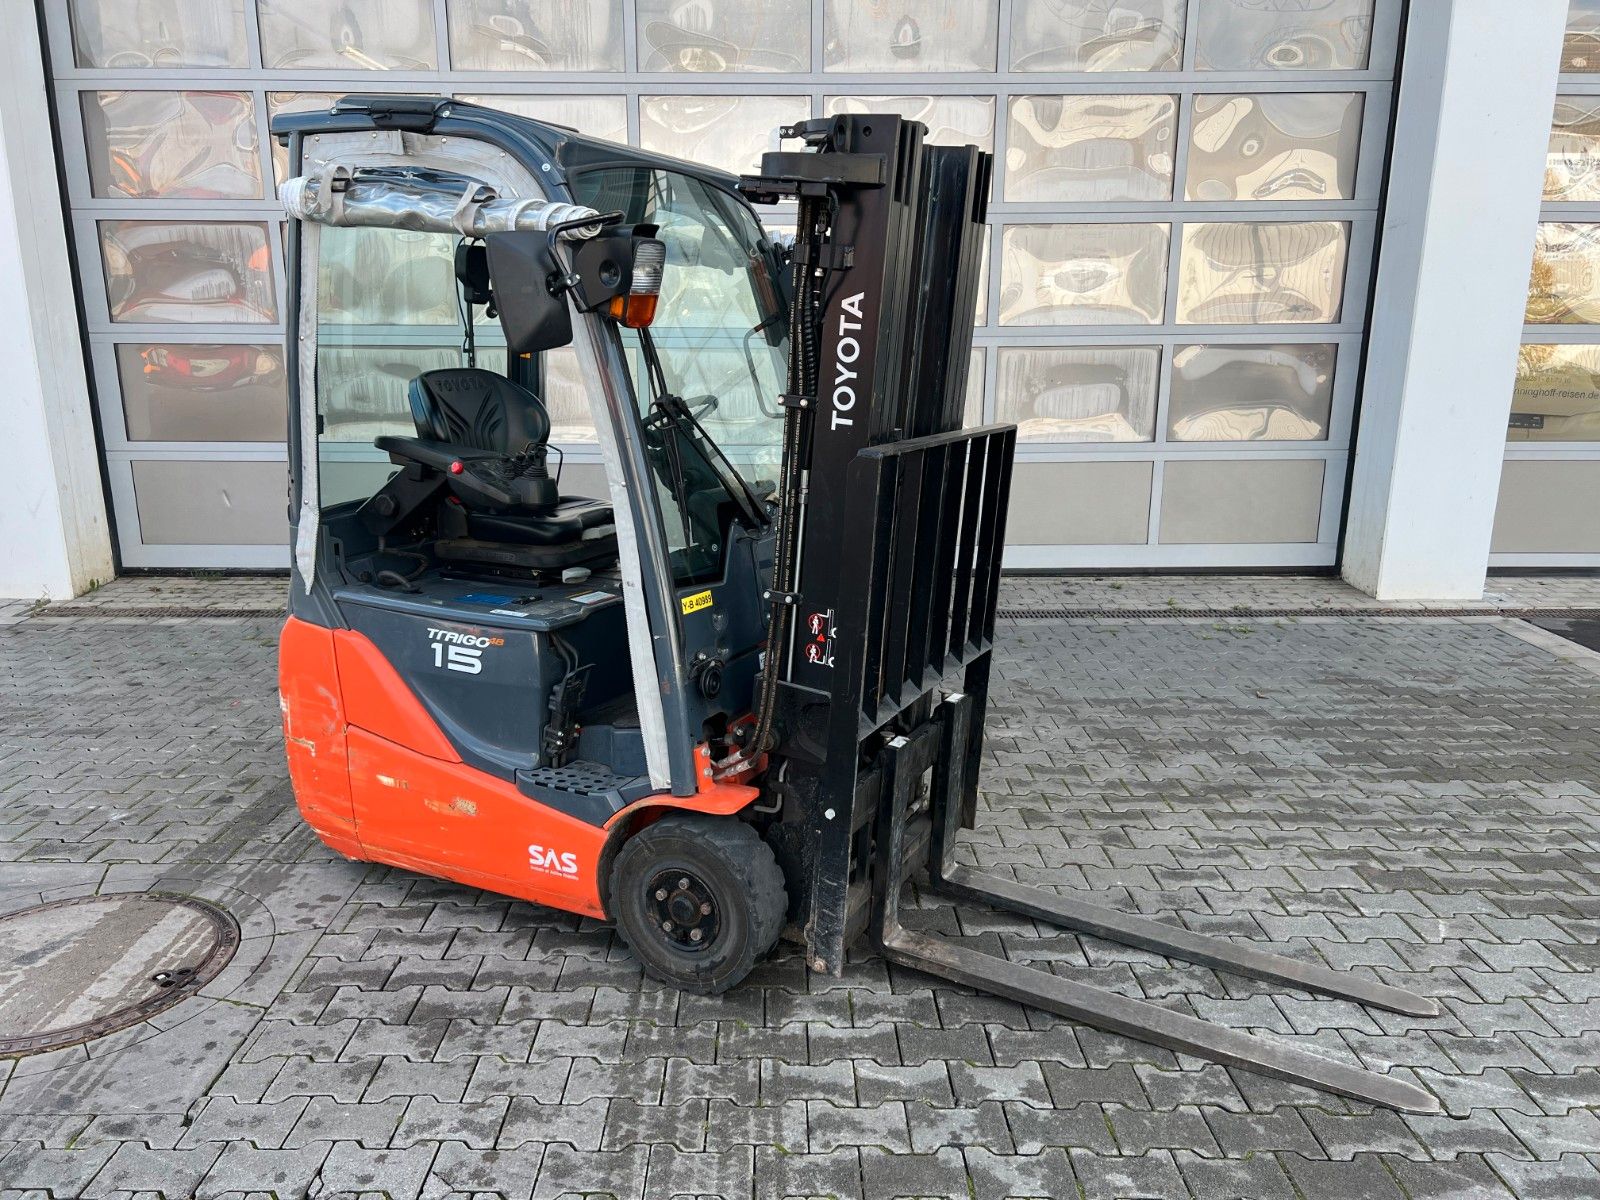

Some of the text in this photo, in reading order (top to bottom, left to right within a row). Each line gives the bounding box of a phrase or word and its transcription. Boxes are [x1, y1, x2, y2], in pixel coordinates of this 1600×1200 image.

[831, 291, 865, 431] TOYOTA
[431, 642, 482, 675] 15
[528, 844, 578, 873] SAS
